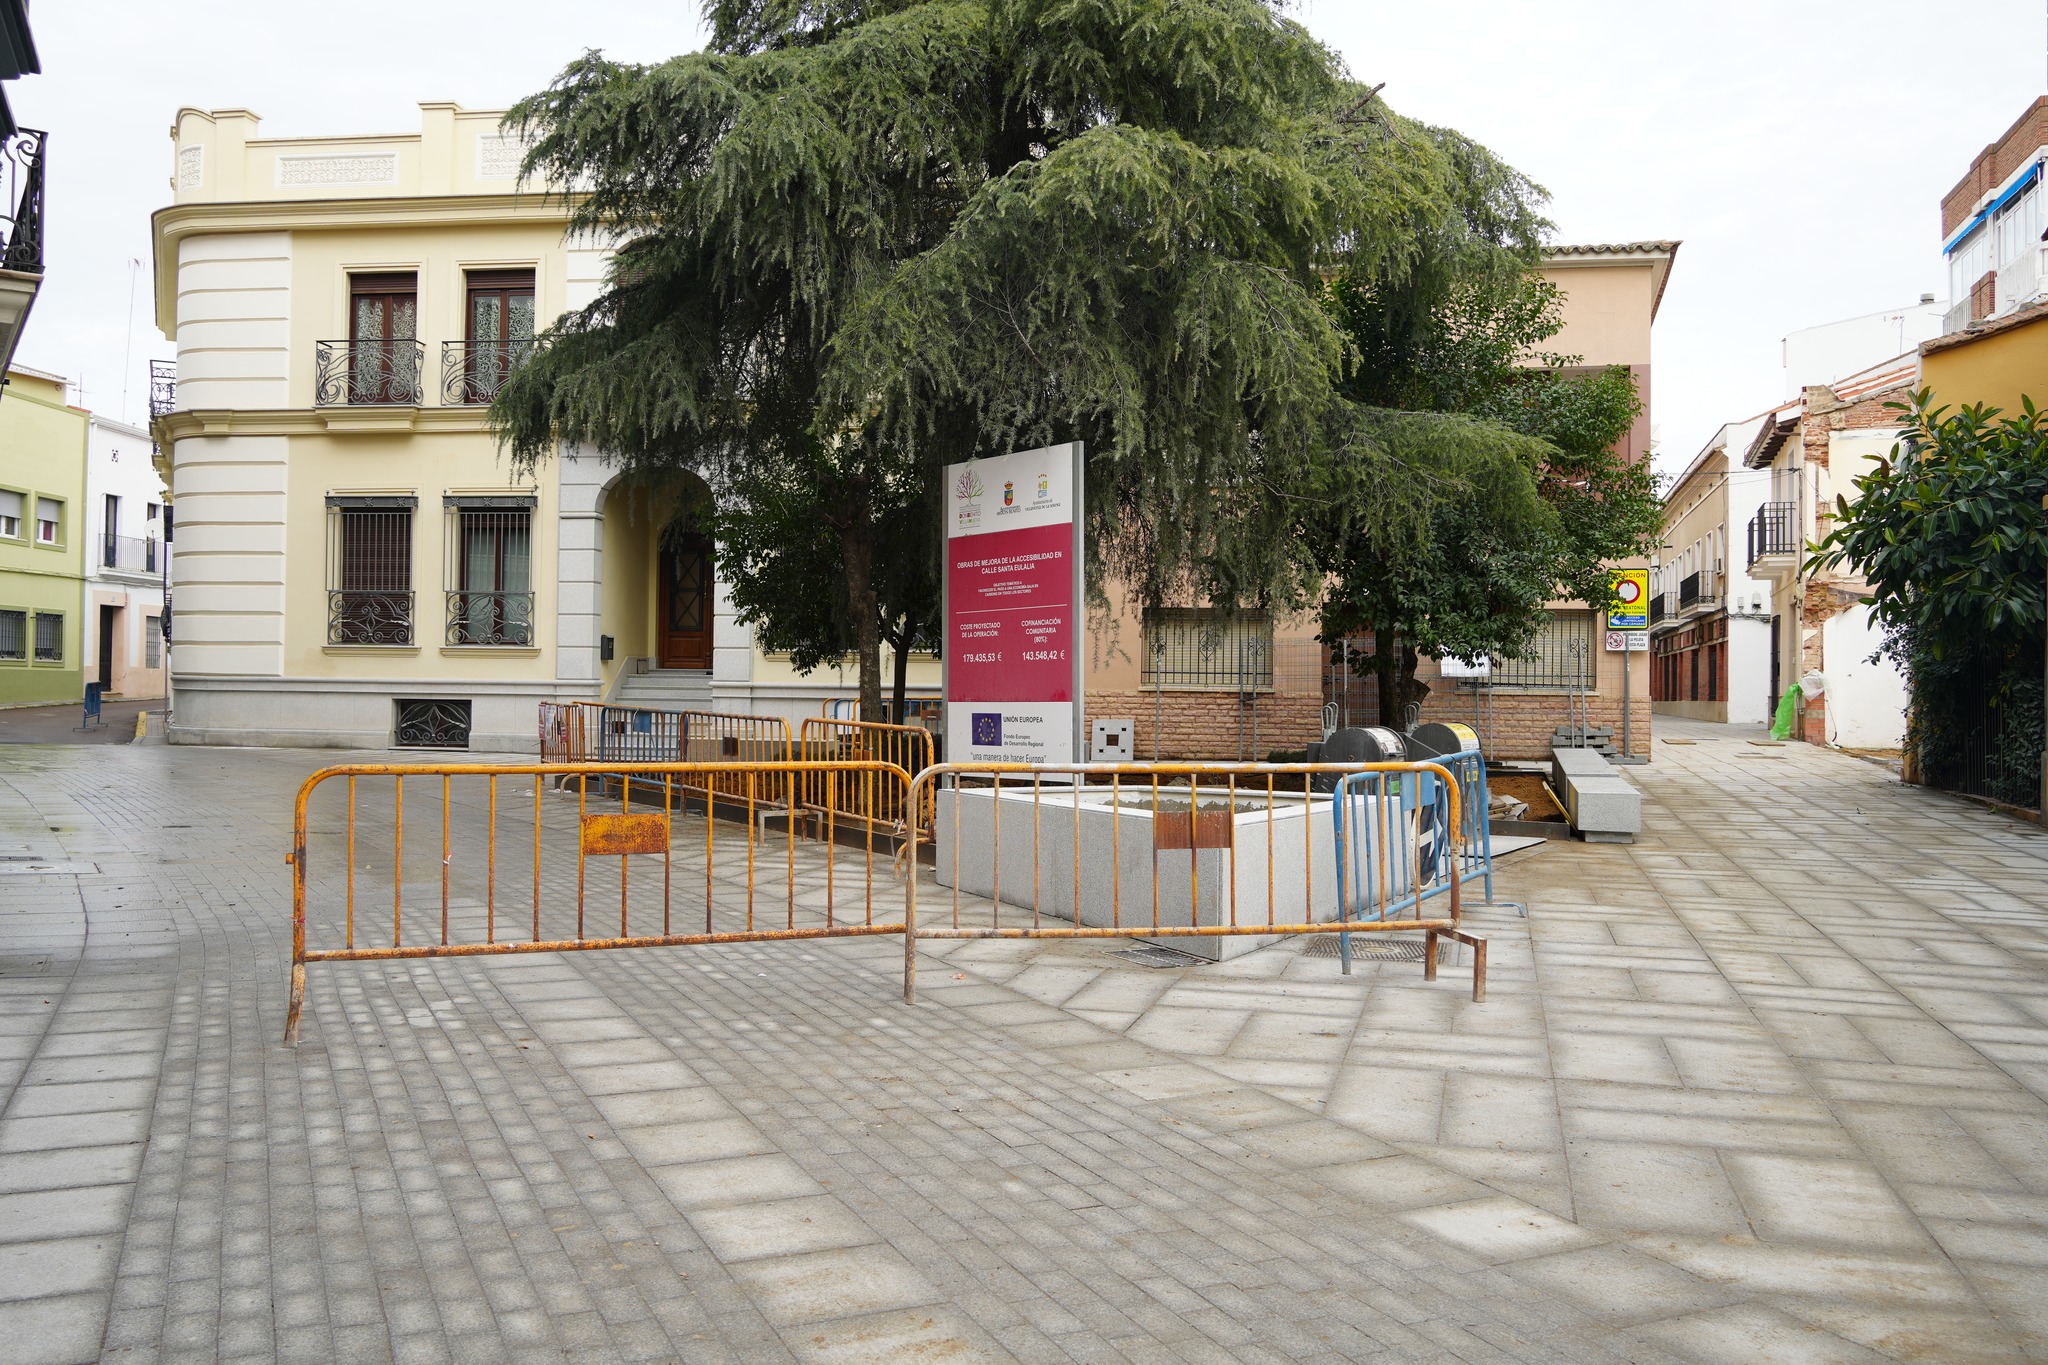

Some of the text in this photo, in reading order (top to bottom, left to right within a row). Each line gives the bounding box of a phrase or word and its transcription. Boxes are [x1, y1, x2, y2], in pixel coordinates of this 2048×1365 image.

[981, 558, 1001, 566] MEJORA
[1016, 552, 1054, 562] ACCESIBILIDAD
[982, 566, 997, 574] CALLE
[1014, 563, 1035, 571] EULALIA
[1021, 617, 1061, 627] COFINANCIACIÓN
[963, 652, 1002, 663] 179.435,53 €
[1022, 650, 1065, 661] 143.548,42 €
[1010, 754, 1024, 762] hacer
